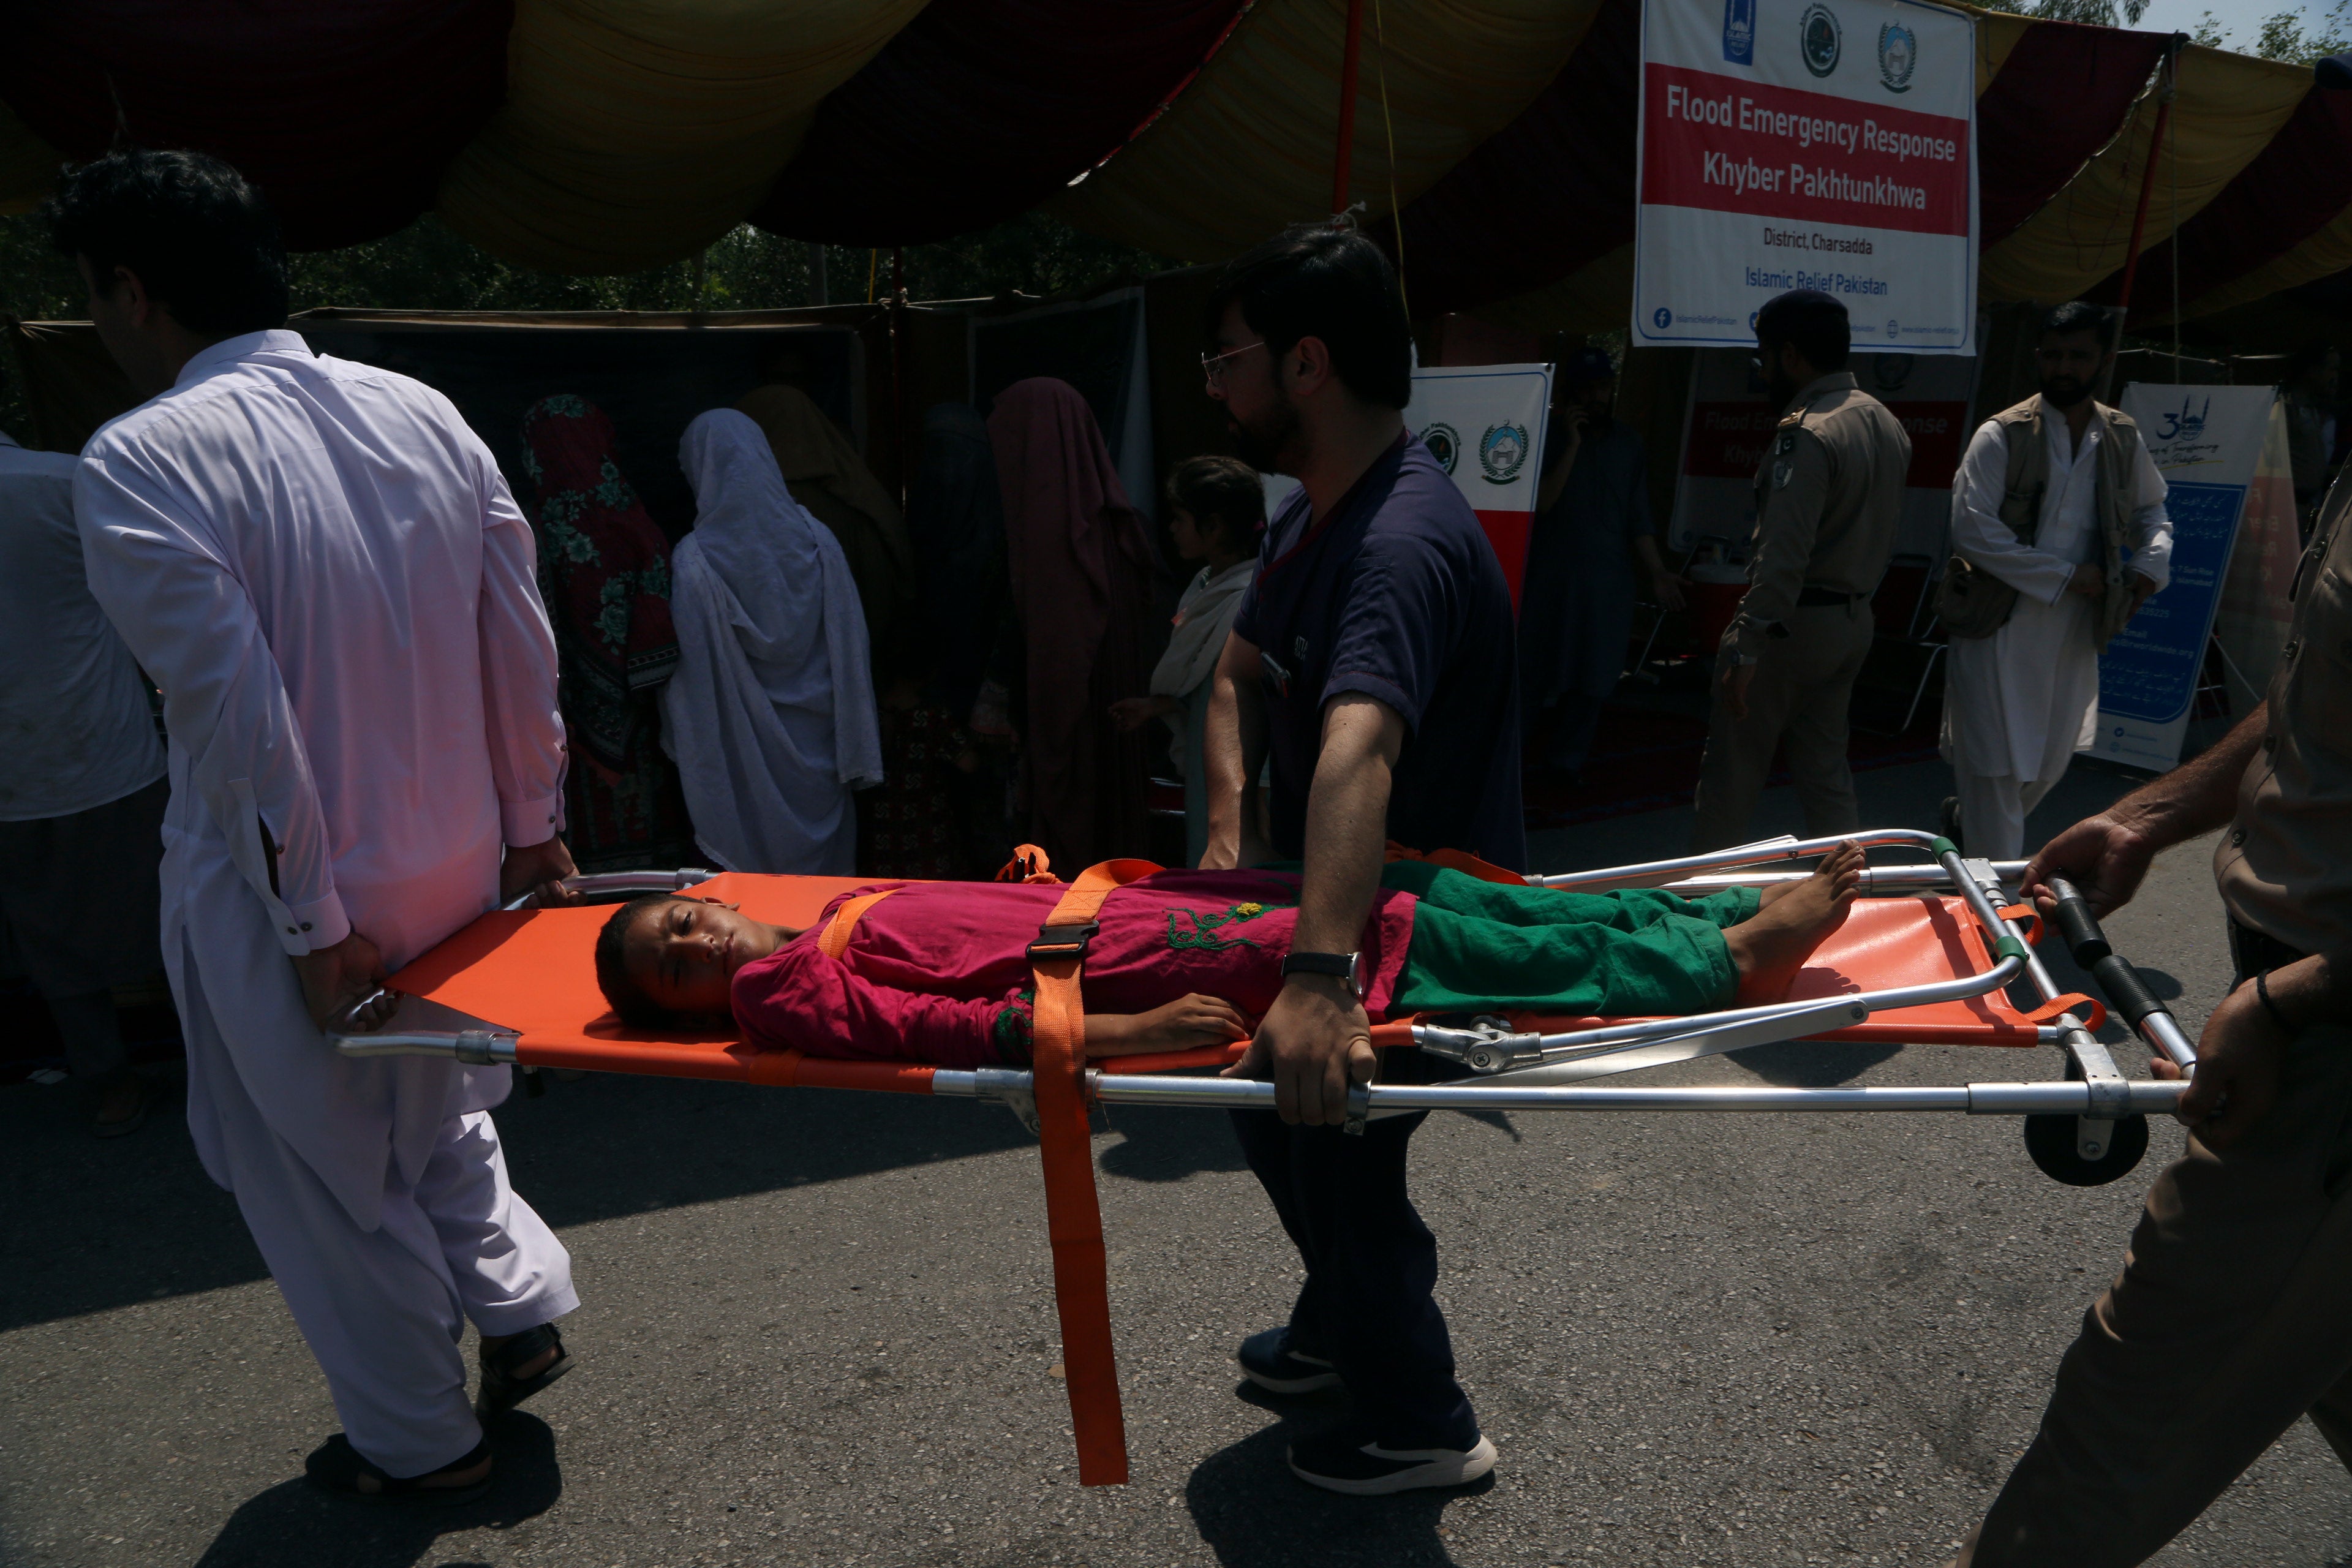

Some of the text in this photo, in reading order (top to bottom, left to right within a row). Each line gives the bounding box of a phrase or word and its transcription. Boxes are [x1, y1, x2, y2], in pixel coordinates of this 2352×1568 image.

[1666, 85, 1956, 162] Flood Emergency Response
[1703, 151, 1926, 211] Khyber Pakhtunkhwa
[1764, 227, 1872, 255] District, Charsadda
[1746, 266, 1888, 296] Islamic Relief Pakistan
[1705, 412, 1749, 431] Flood
[1900, 417, 1948, 435] onse
[1723, 445, 1765, 467] Khyb
[2122, 627, 2148, 639] Email
